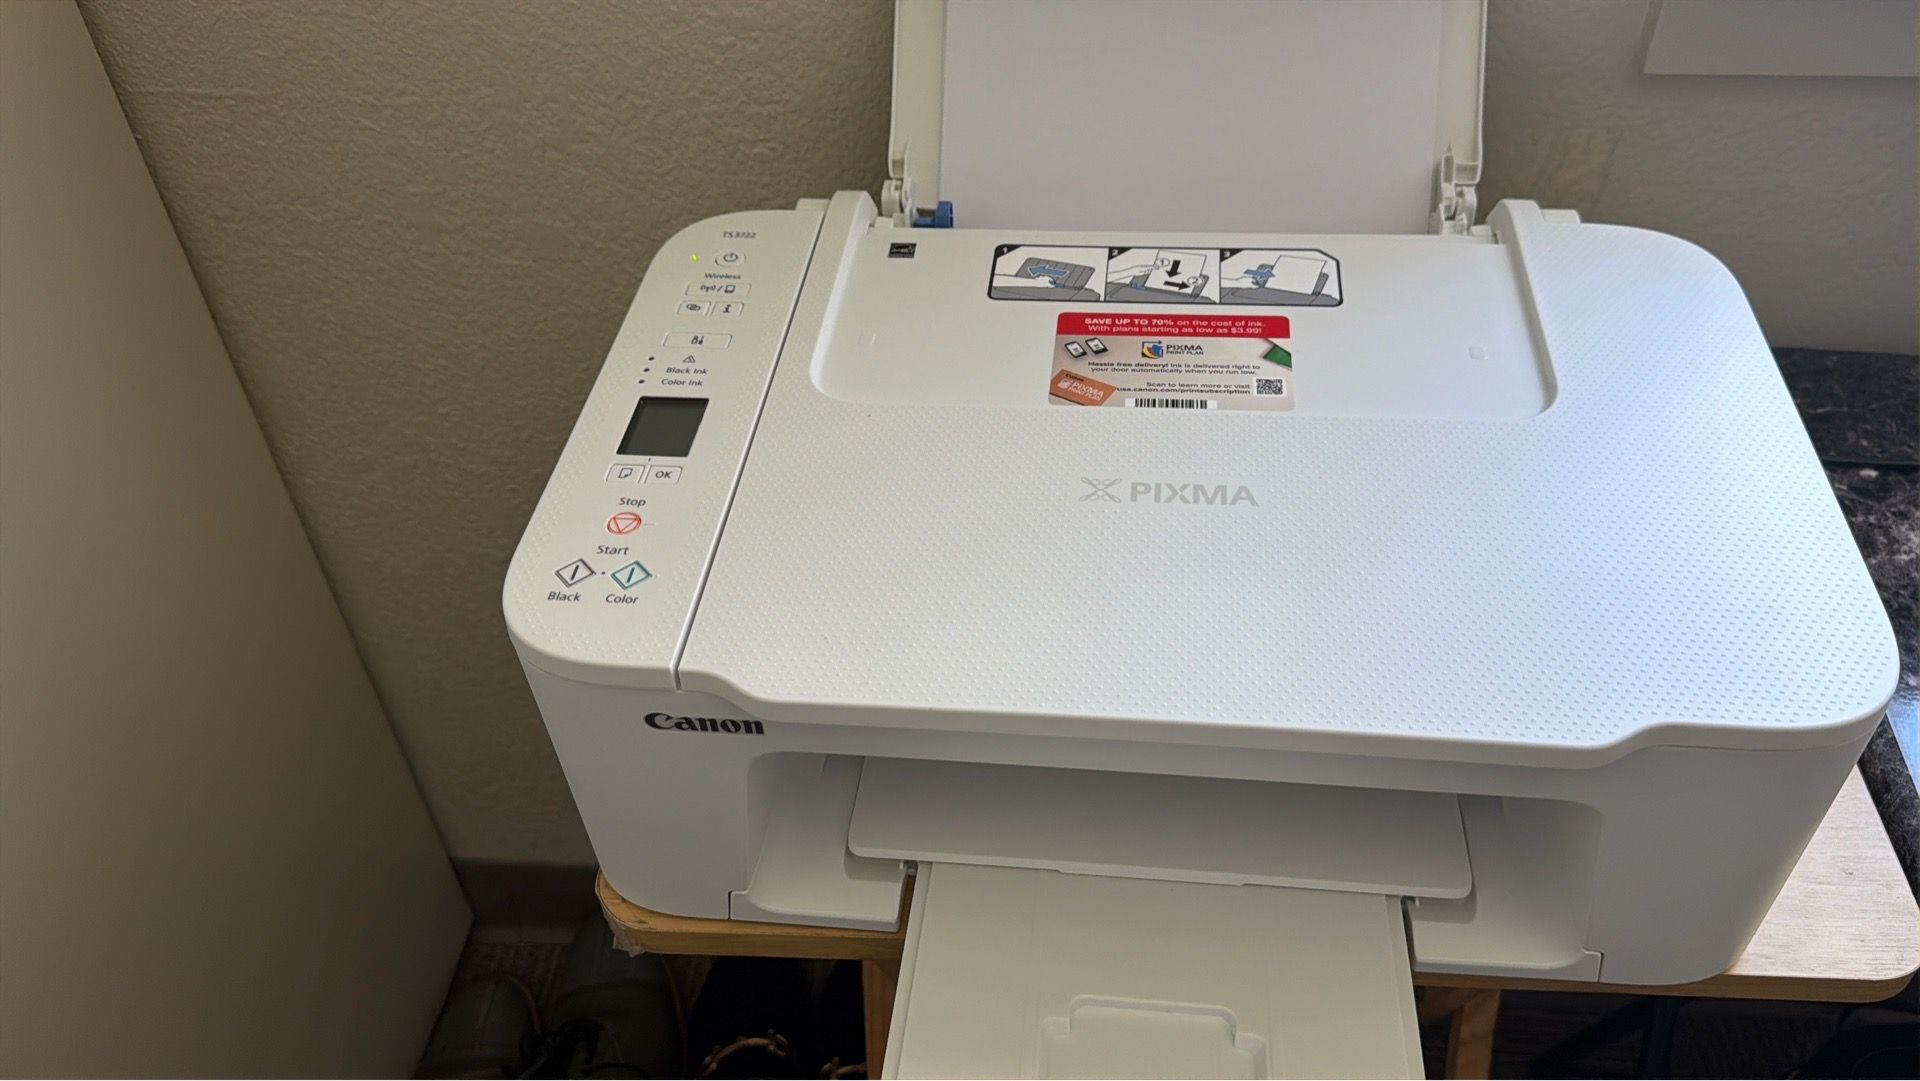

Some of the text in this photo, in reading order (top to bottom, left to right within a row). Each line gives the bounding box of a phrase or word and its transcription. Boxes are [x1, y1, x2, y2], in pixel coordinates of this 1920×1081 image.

[723, 231, 756, 239] TS3722
[705, 272, 741, 280] Wireless
[666, 366, 690, 374] Black
[688, 379, 703, 387] Ink
[1070, 381, 1104, 398] PIXMA
[655, 471, 672, 479] OK
[1130, 482, 1260, 507] PIXMA
[619, 497, 646, 508] Stop
[596, 544, 629, 556] Start
[547, 591, 581, 602] Black
[605, 593, 639, 604] Color
[644, 712, 765, 735] Canon
